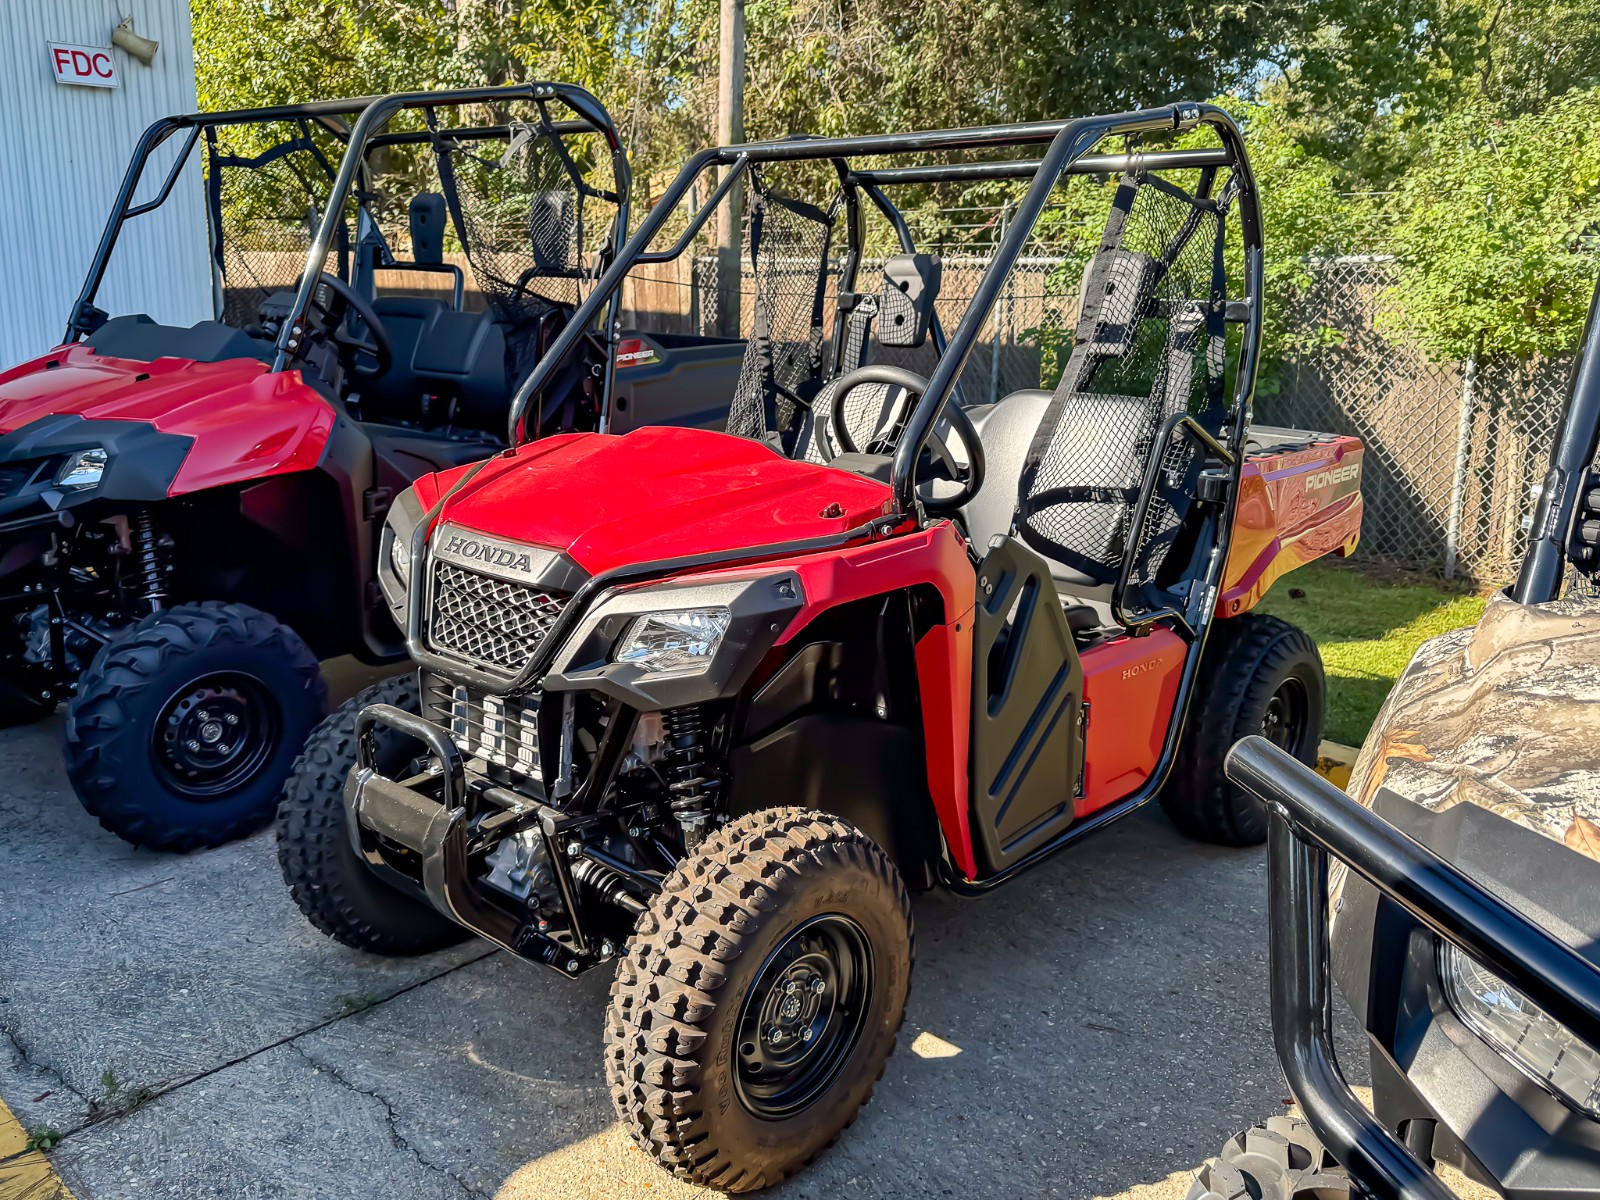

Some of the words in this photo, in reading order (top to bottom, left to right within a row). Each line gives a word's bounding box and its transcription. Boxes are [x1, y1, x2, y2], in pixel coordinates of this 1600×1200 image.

[53, 48, 113, 78] FDC
[616, 349, 654, 362] PIONEER
[1305, 463, 1359, 493] PIONEER
[444, 536, 531, 573] HONDA
